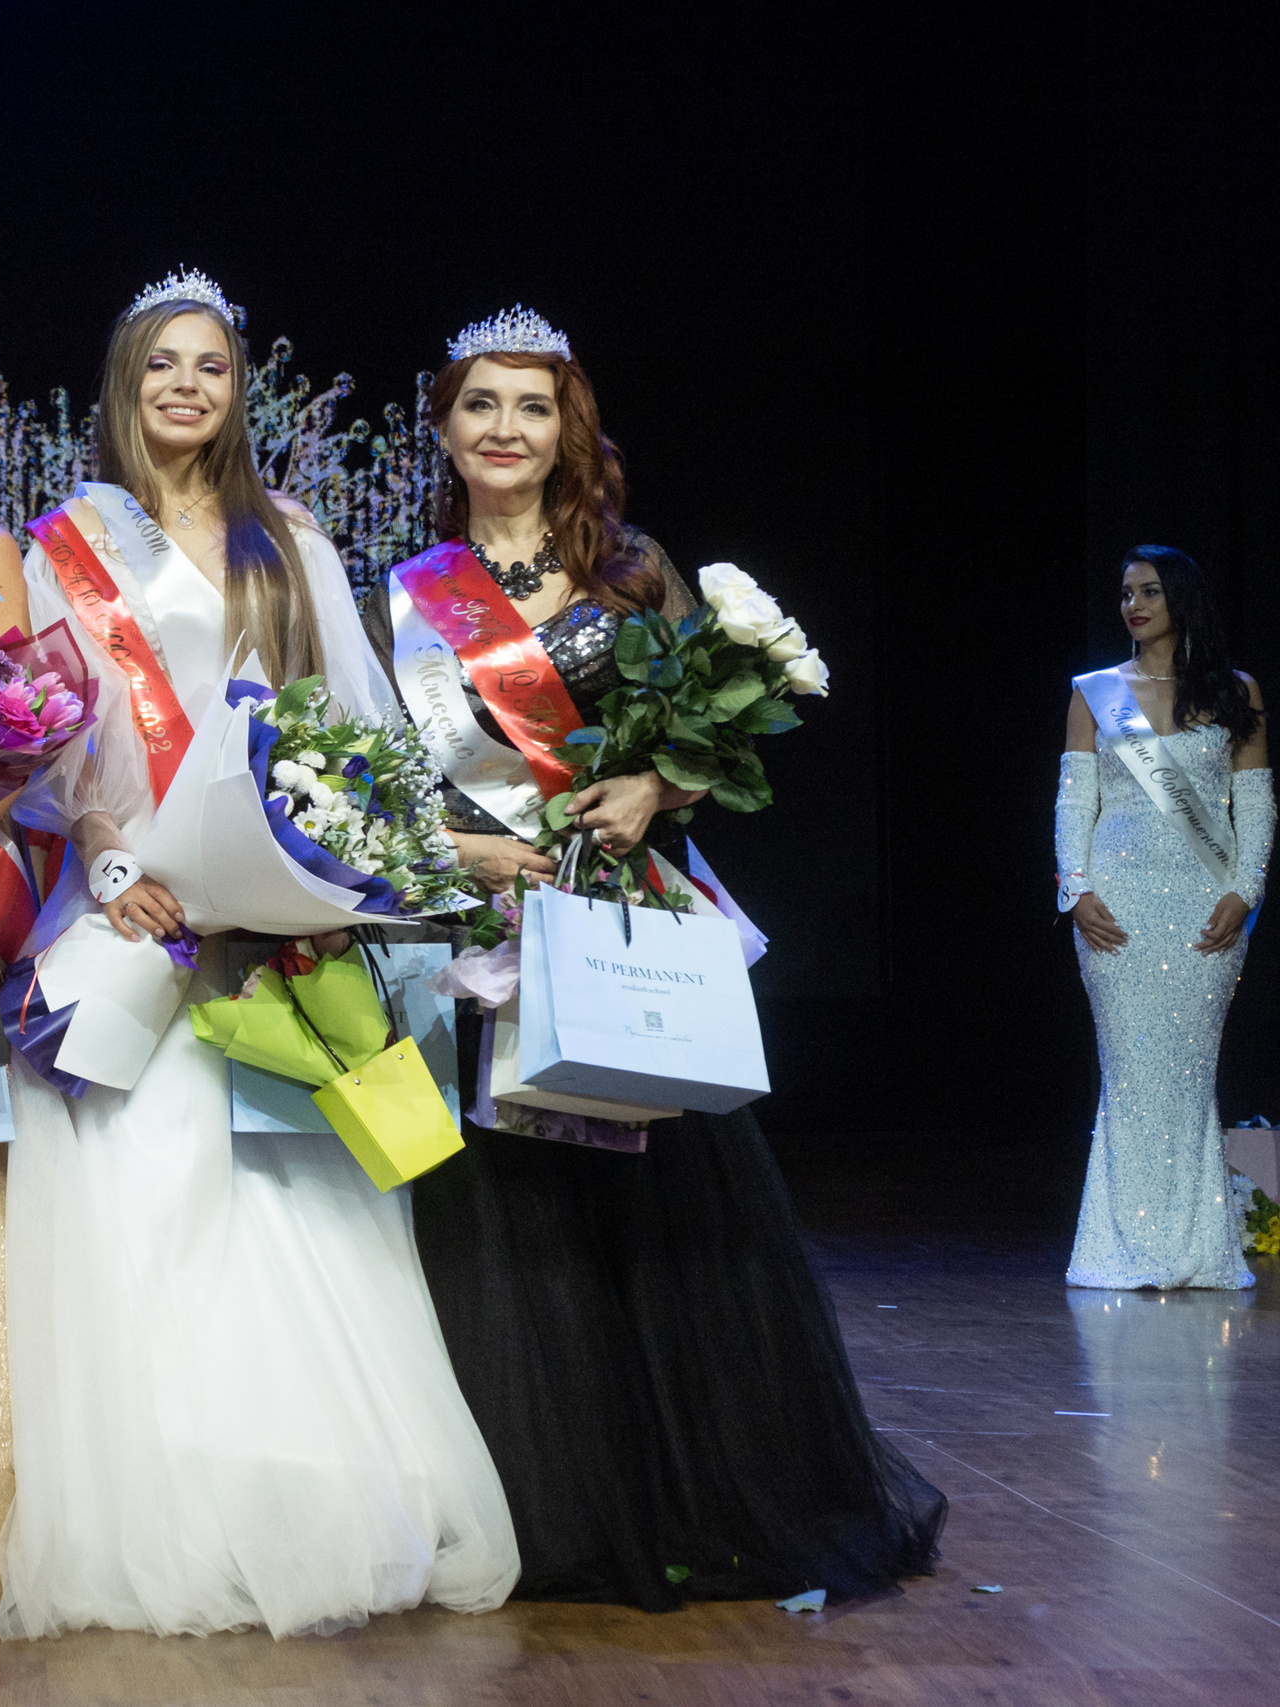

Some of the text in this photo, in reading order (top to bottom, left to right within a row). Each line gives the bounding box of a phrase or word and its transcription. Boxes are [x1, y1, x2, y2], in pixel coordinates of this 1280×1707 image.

[414, 643, 475, 760] Миссис
[1110, 707, 1230, 870] Миссис Совершенст
[102, 859, 128, 884] 5
[1060, 885, 1070, 904] 8
[585, 956, 706, 986] MT PERMANENT
